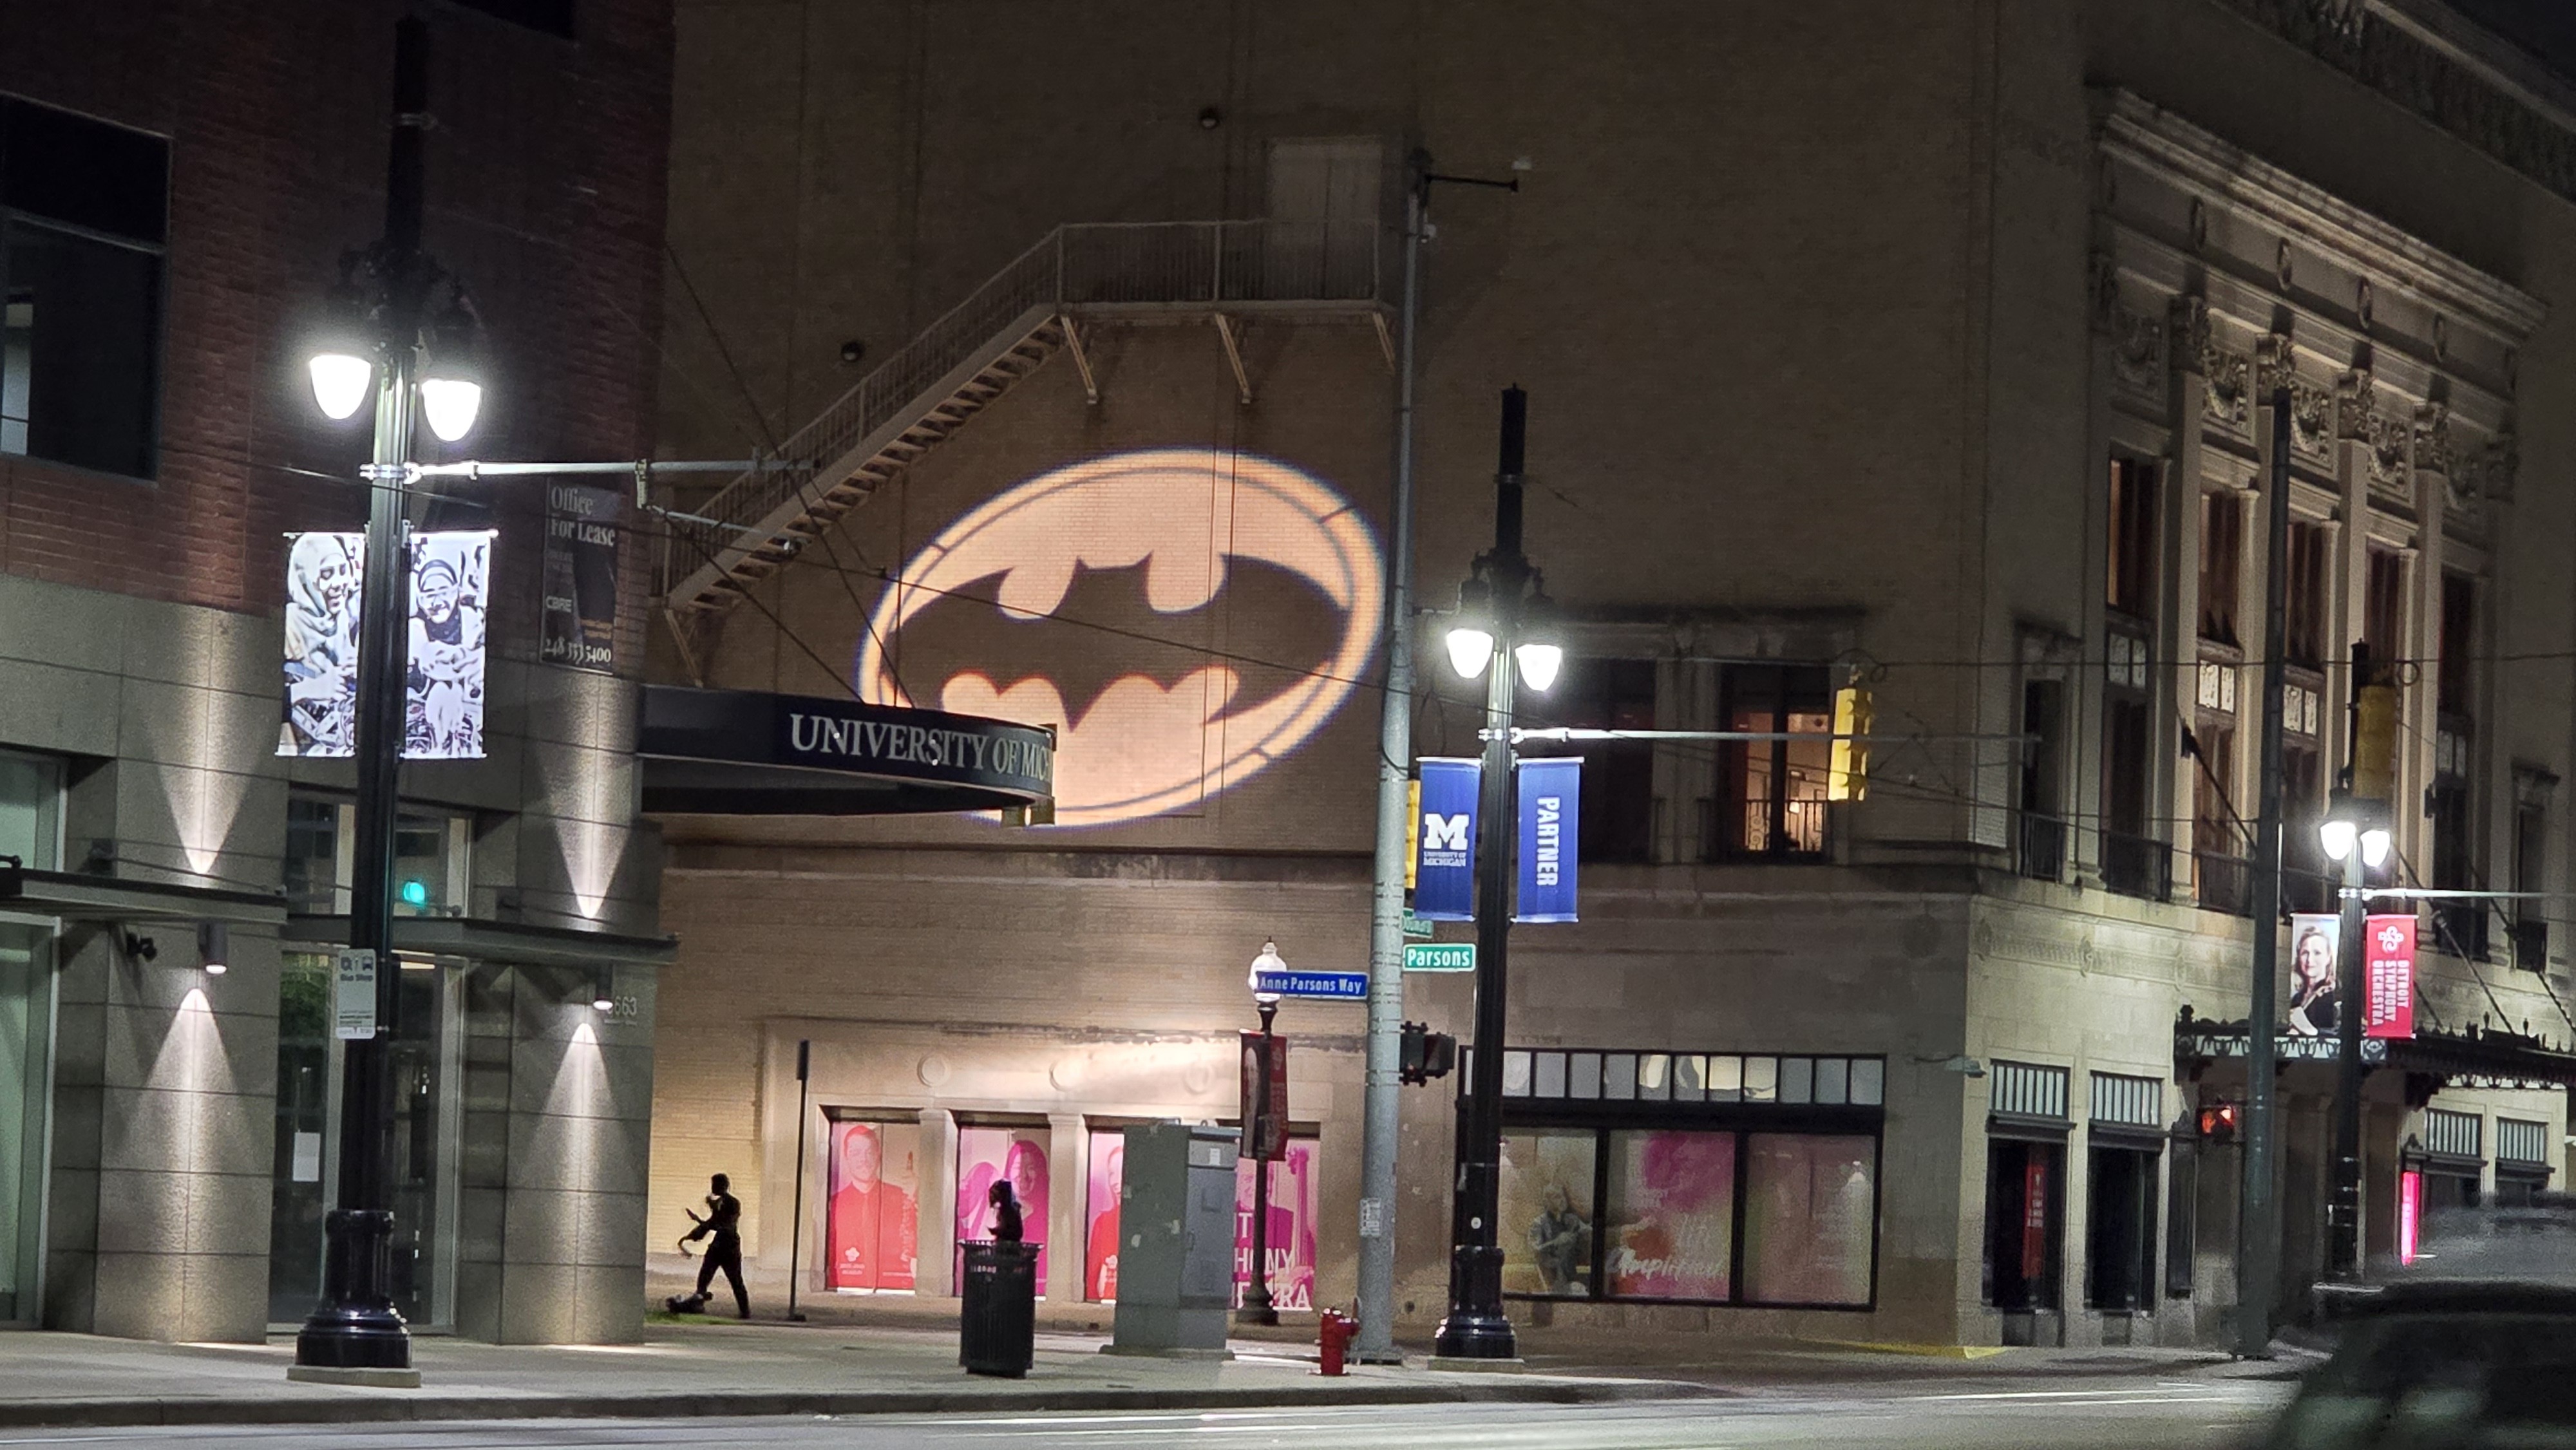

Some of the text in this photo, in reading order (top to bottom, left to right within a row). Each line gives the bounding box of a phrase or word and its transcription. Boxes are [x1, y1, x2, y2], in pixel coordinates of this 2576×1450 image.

[551, 486, 594, 515] Office
[551, 513, 616, 547] For Lease
[790, 713, 989, 770] UNIVERSITY
[992, 737, 1018, 773] OF
[1423, 813, 1470, 851] M
[1537, 796, 1560, 886] PARTNER
[1408, 948, 1470, 966] Parsons
[1260, 976, 1362, 995] Anne Parsons Way
[2372, 959, 2384, 1026] ORCHESTRA
[2385, 959, 2396, 1022] SYMPHONY
[2397, 959, 2410, 1009] DETROIT
